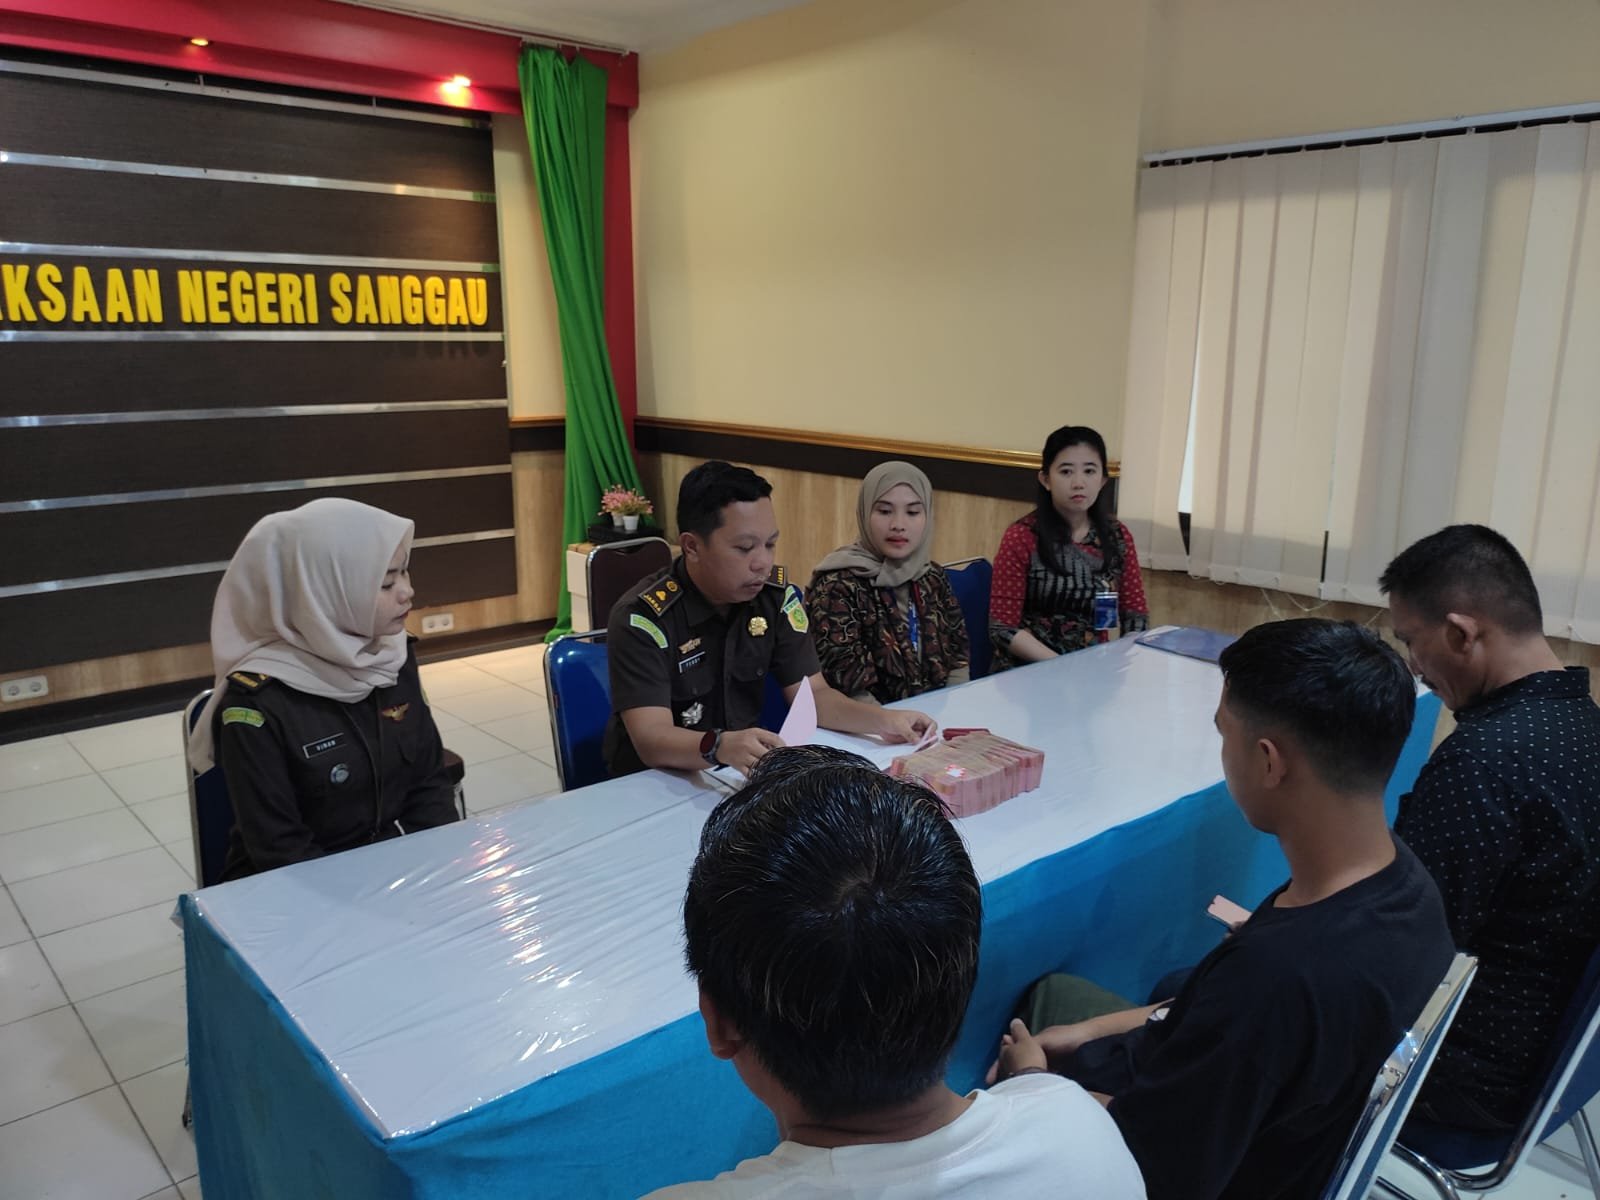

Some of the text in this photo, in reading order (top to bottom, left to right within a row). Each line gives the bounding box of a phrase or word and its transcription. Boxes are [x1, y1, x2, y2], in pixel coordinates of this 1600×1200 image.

[0, 263, 488, 326] KSAAN NEGERI SANGGAU
